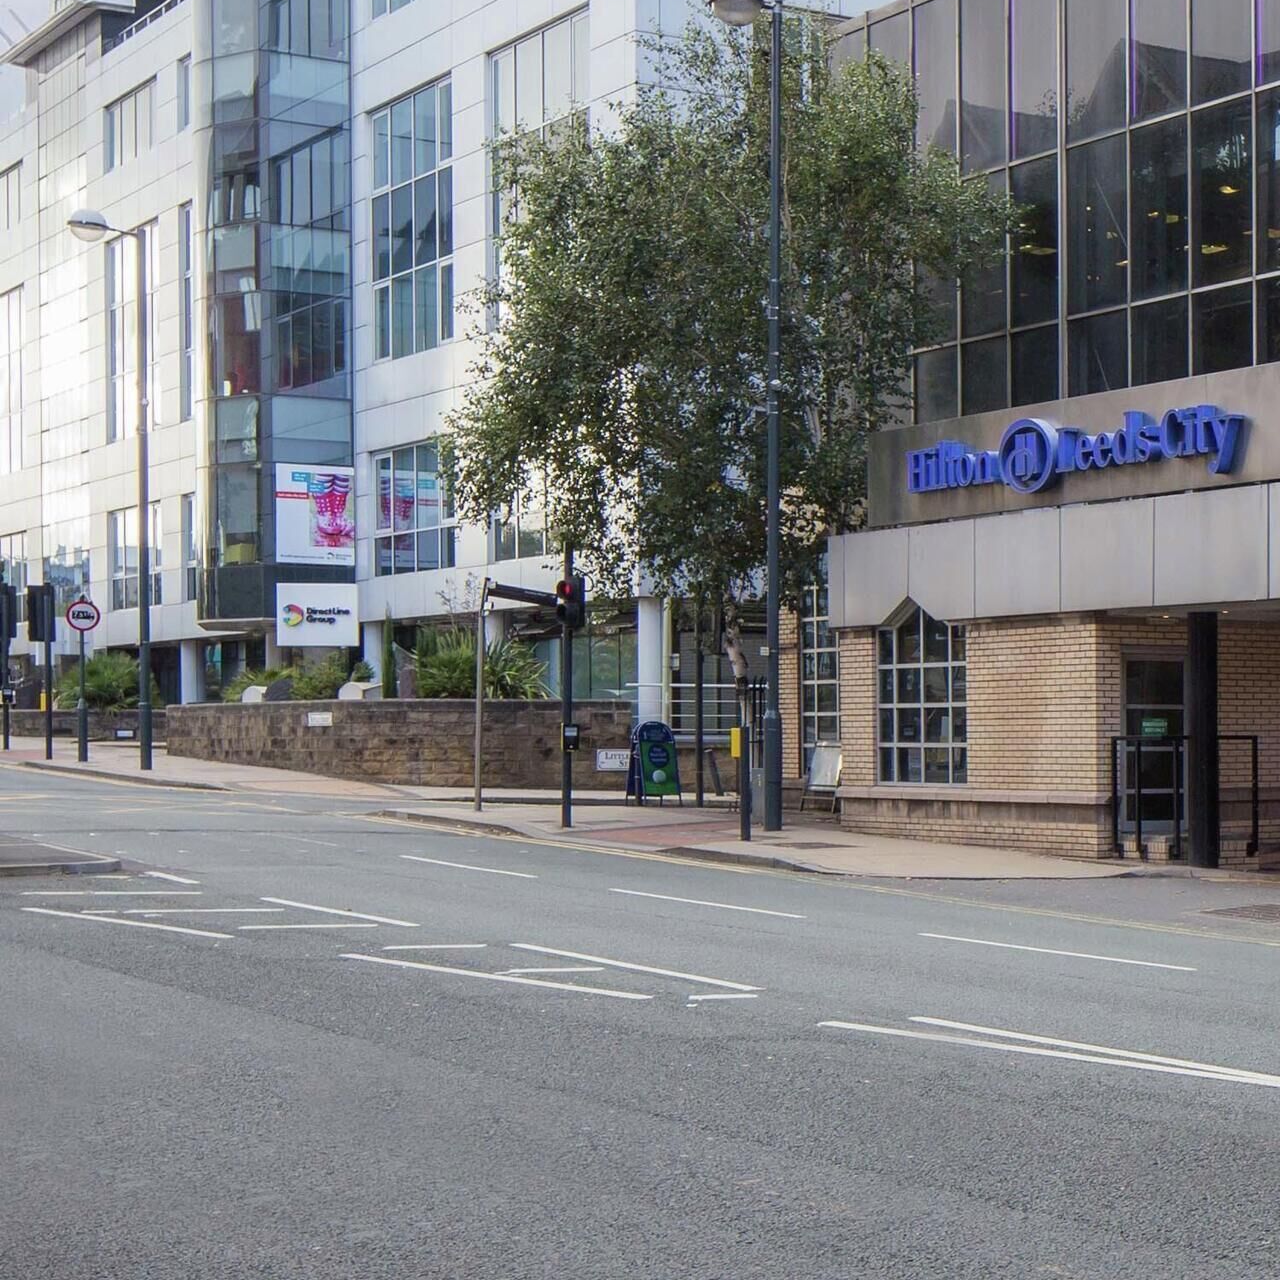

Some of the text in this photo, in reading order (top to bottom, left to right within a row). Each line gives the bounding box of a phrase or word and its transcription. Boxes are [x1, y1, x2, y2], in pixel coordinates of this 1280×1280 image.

[907, 439, 1000, 494] Hilton
[1055, 410, 1153, 474] Leeds
[1157, 404, 1246, 475] City
[306, 607, 332, 616] Direct
[306, 615, 337, 625] Group
